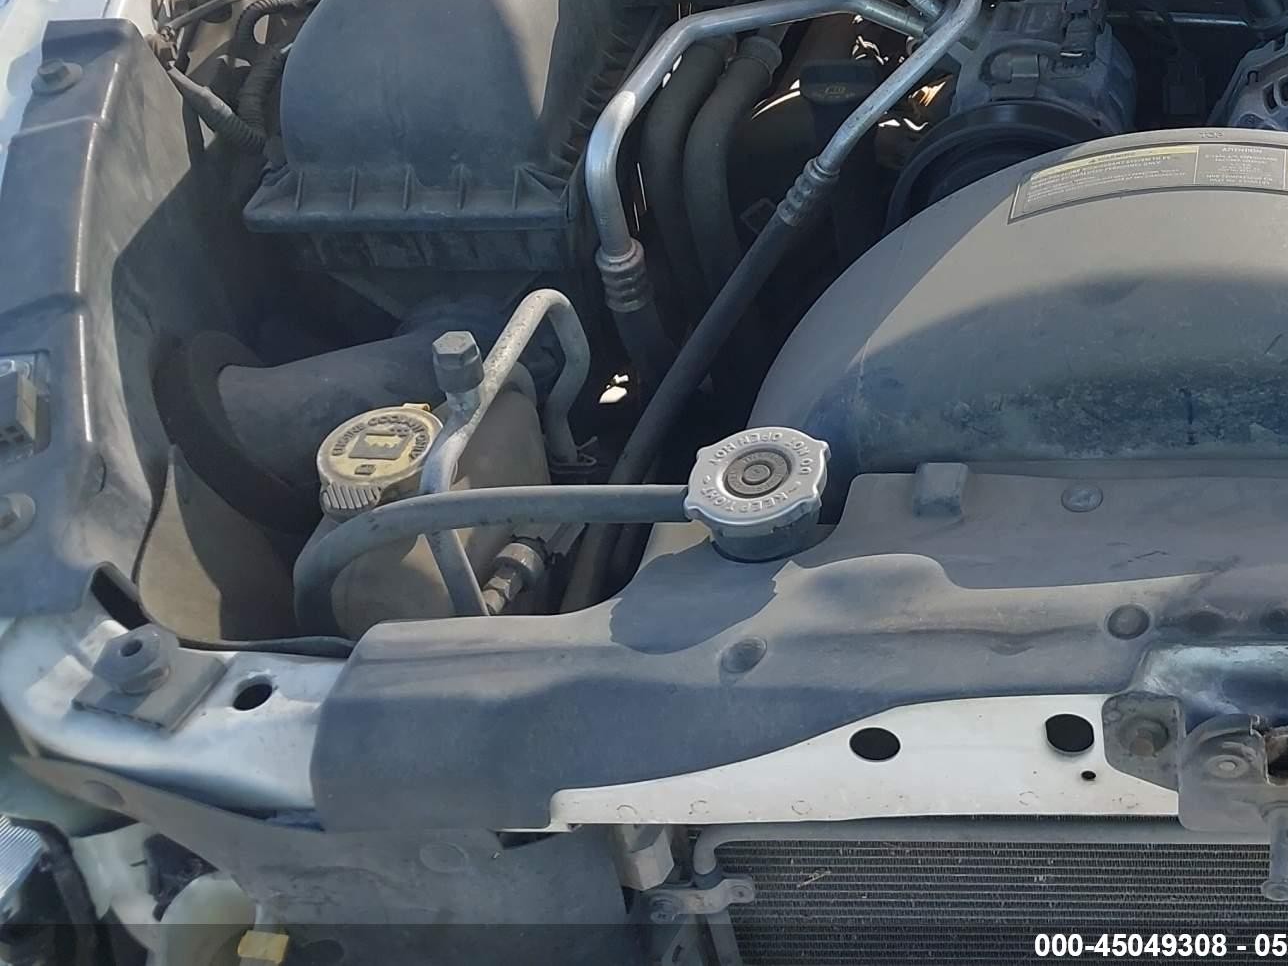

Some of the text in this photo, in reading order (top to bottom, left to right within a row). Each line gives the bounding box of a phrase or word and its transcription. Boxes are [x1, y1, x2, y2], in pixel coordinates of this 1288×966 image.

[331, 422, 366, 456] ENGINE
[368, 416, 426, 433] COOLANT
[740, 432, 783, 445] OPEN
[708, 442, 737, 465] HOT
[739, 492, 788, 512] KEEP
